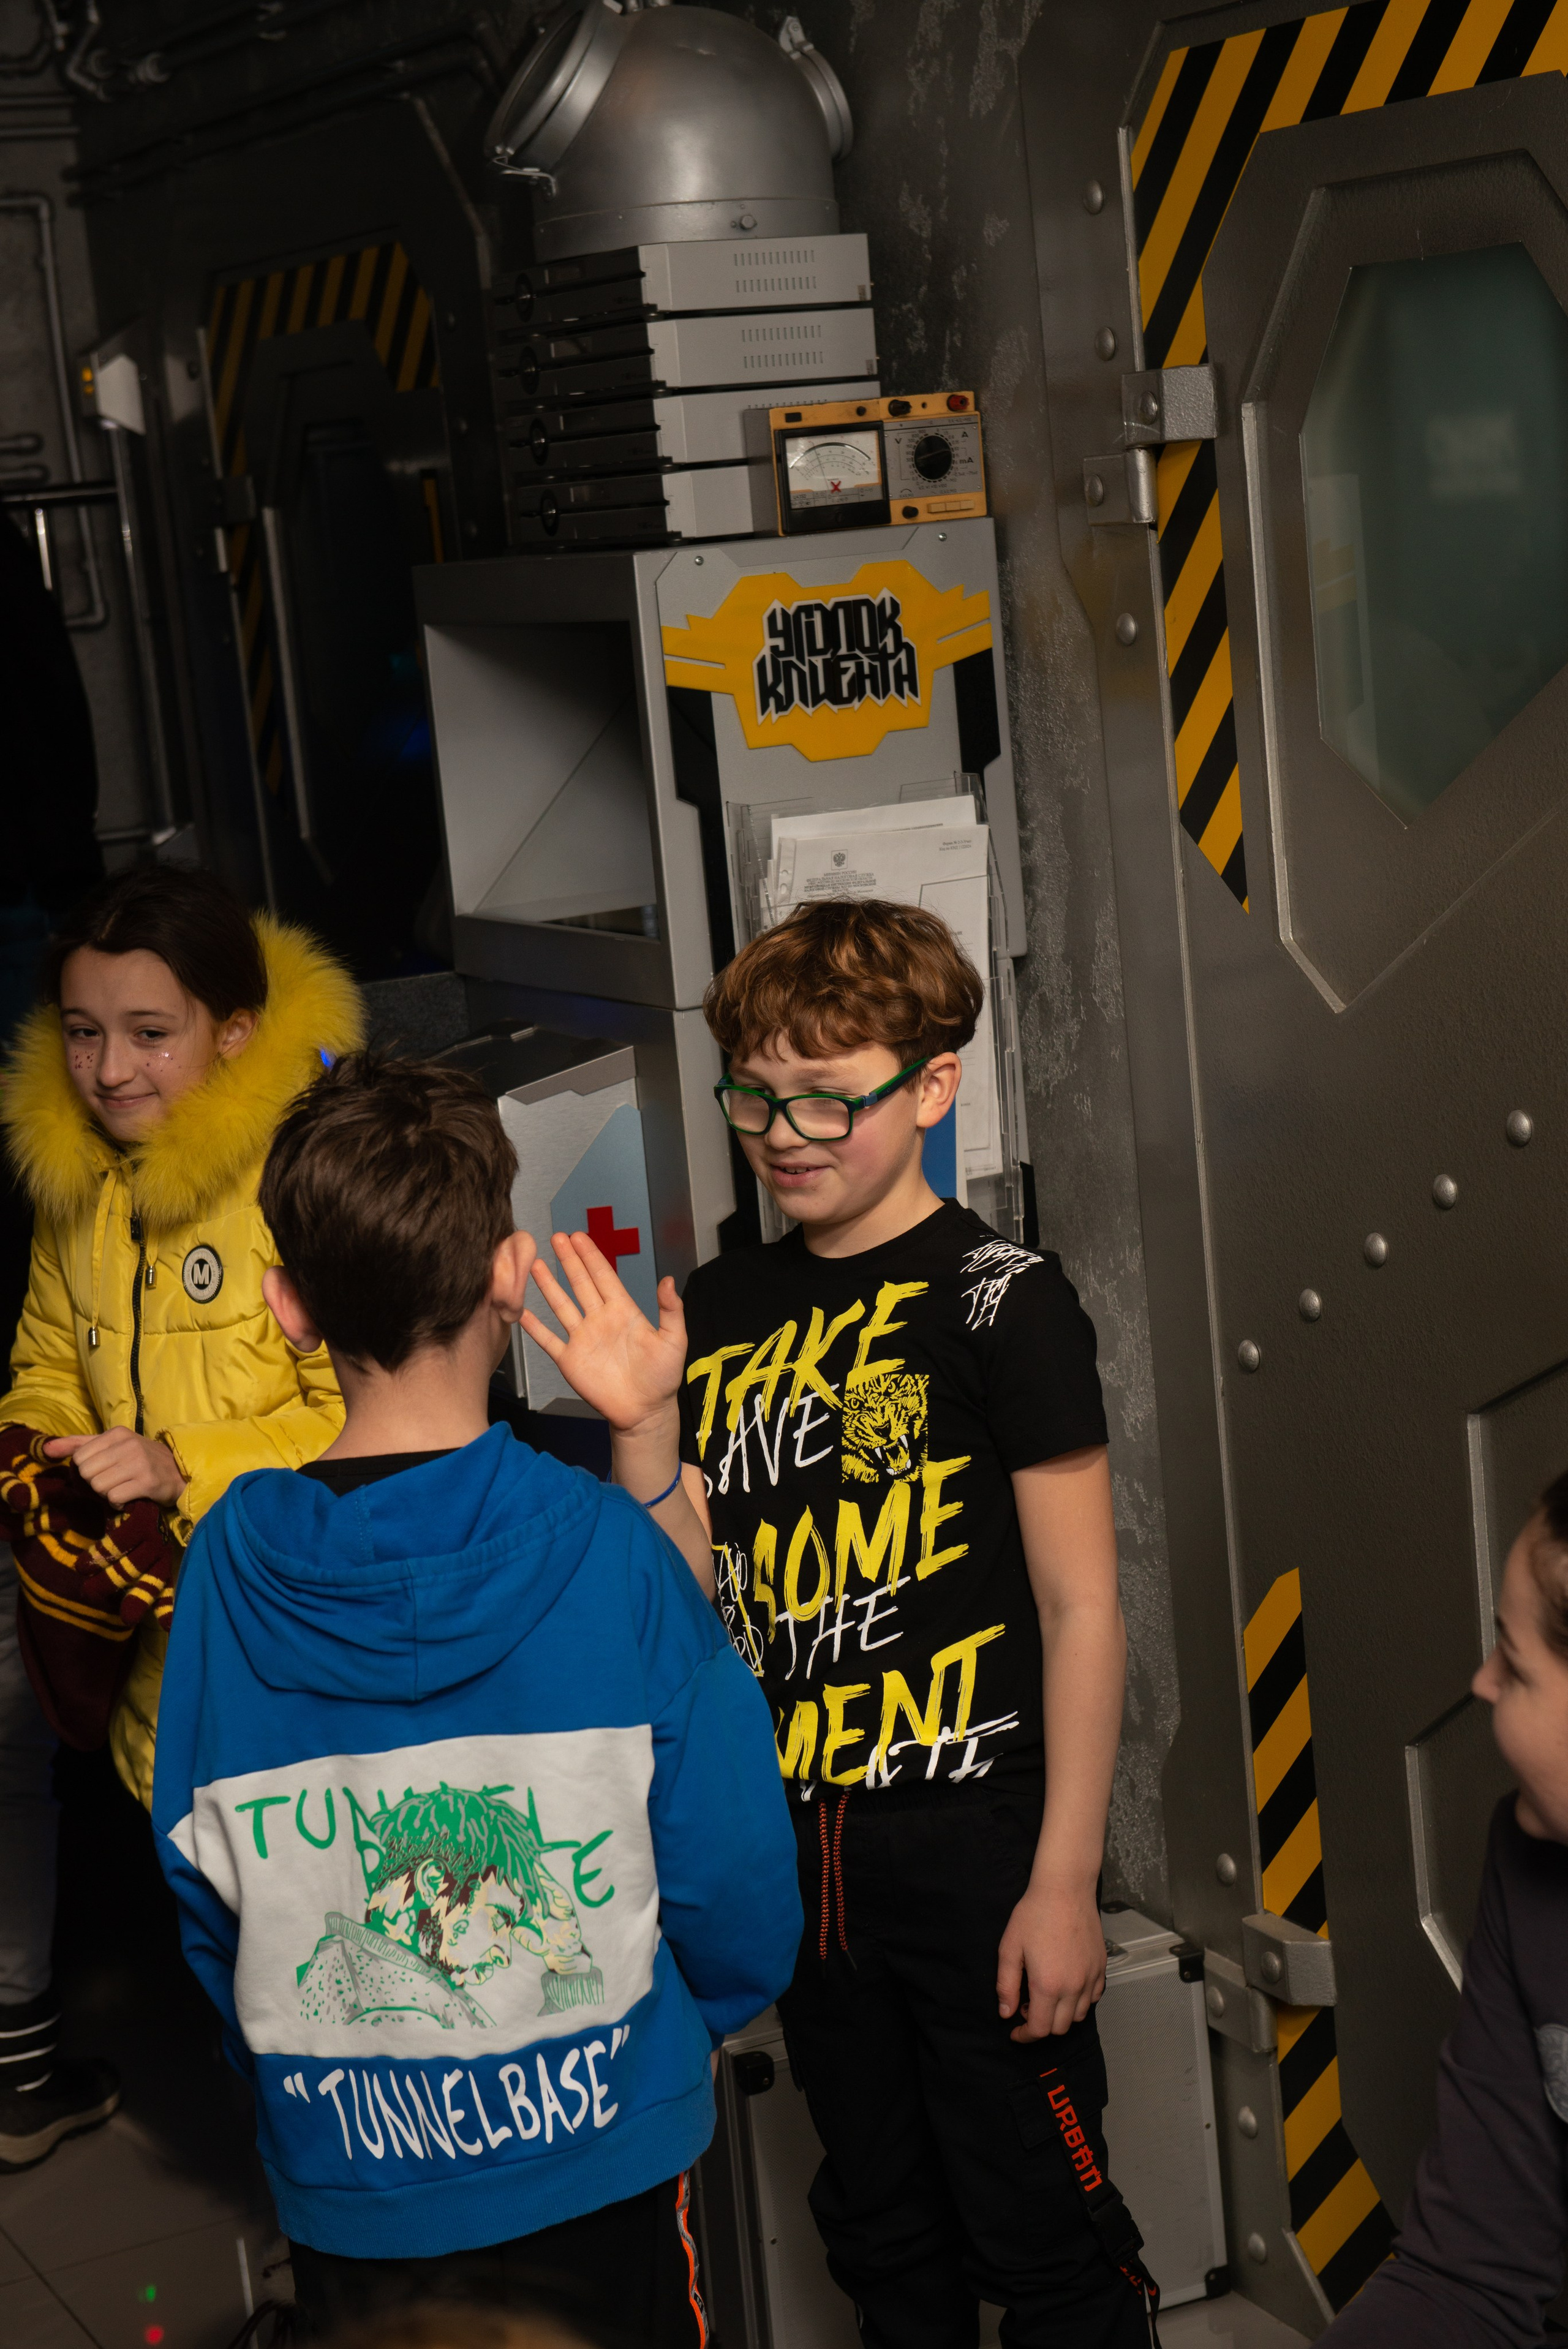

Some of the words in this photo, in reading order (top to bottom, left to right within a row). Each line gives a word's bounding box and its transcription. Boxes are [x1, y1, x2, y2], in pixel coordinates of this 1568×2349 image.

[194, 1263, 209, 1285] M
[687, 1281, 929, 1461] TAKE
[696, 1384, 840, 1499] AVE
[753, 1455, 972, 1644] SOME
[775, 1576, 911, 1680] THE
[1047, 2084, 1102, 2192] URBAN
